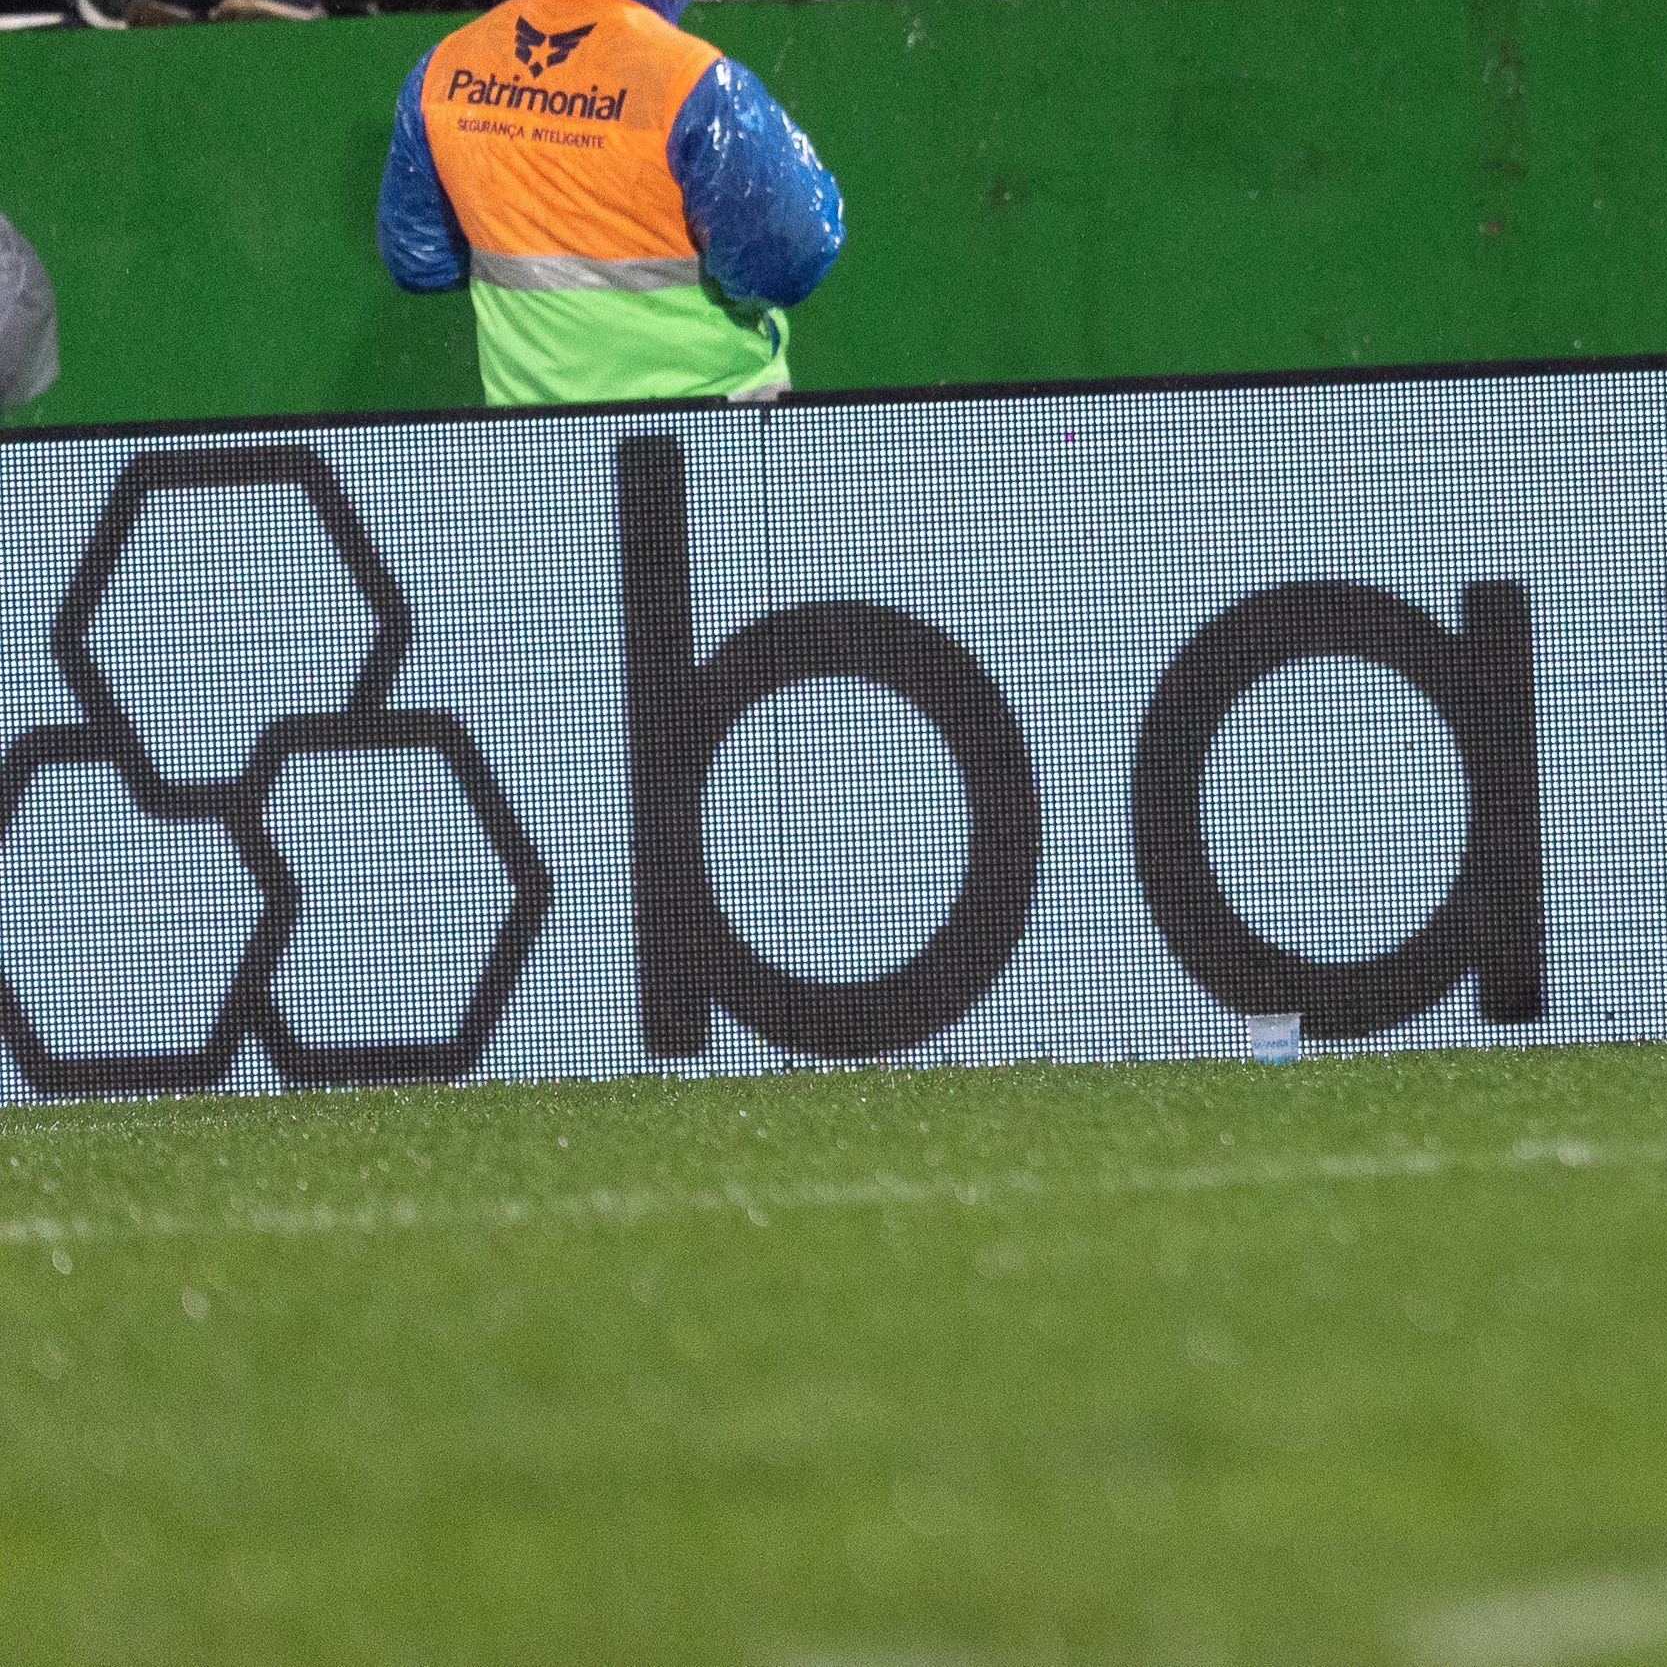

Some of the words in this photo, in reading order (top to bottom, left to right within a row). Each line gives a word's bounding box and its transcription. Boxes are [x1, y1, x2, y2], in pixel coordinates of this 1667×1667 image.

[447, 68, 627, 122] Patrimonial
[457, 118, 526, 142] SEGURANÇA
[530, 127, 605, 149] INTELIGENTE
